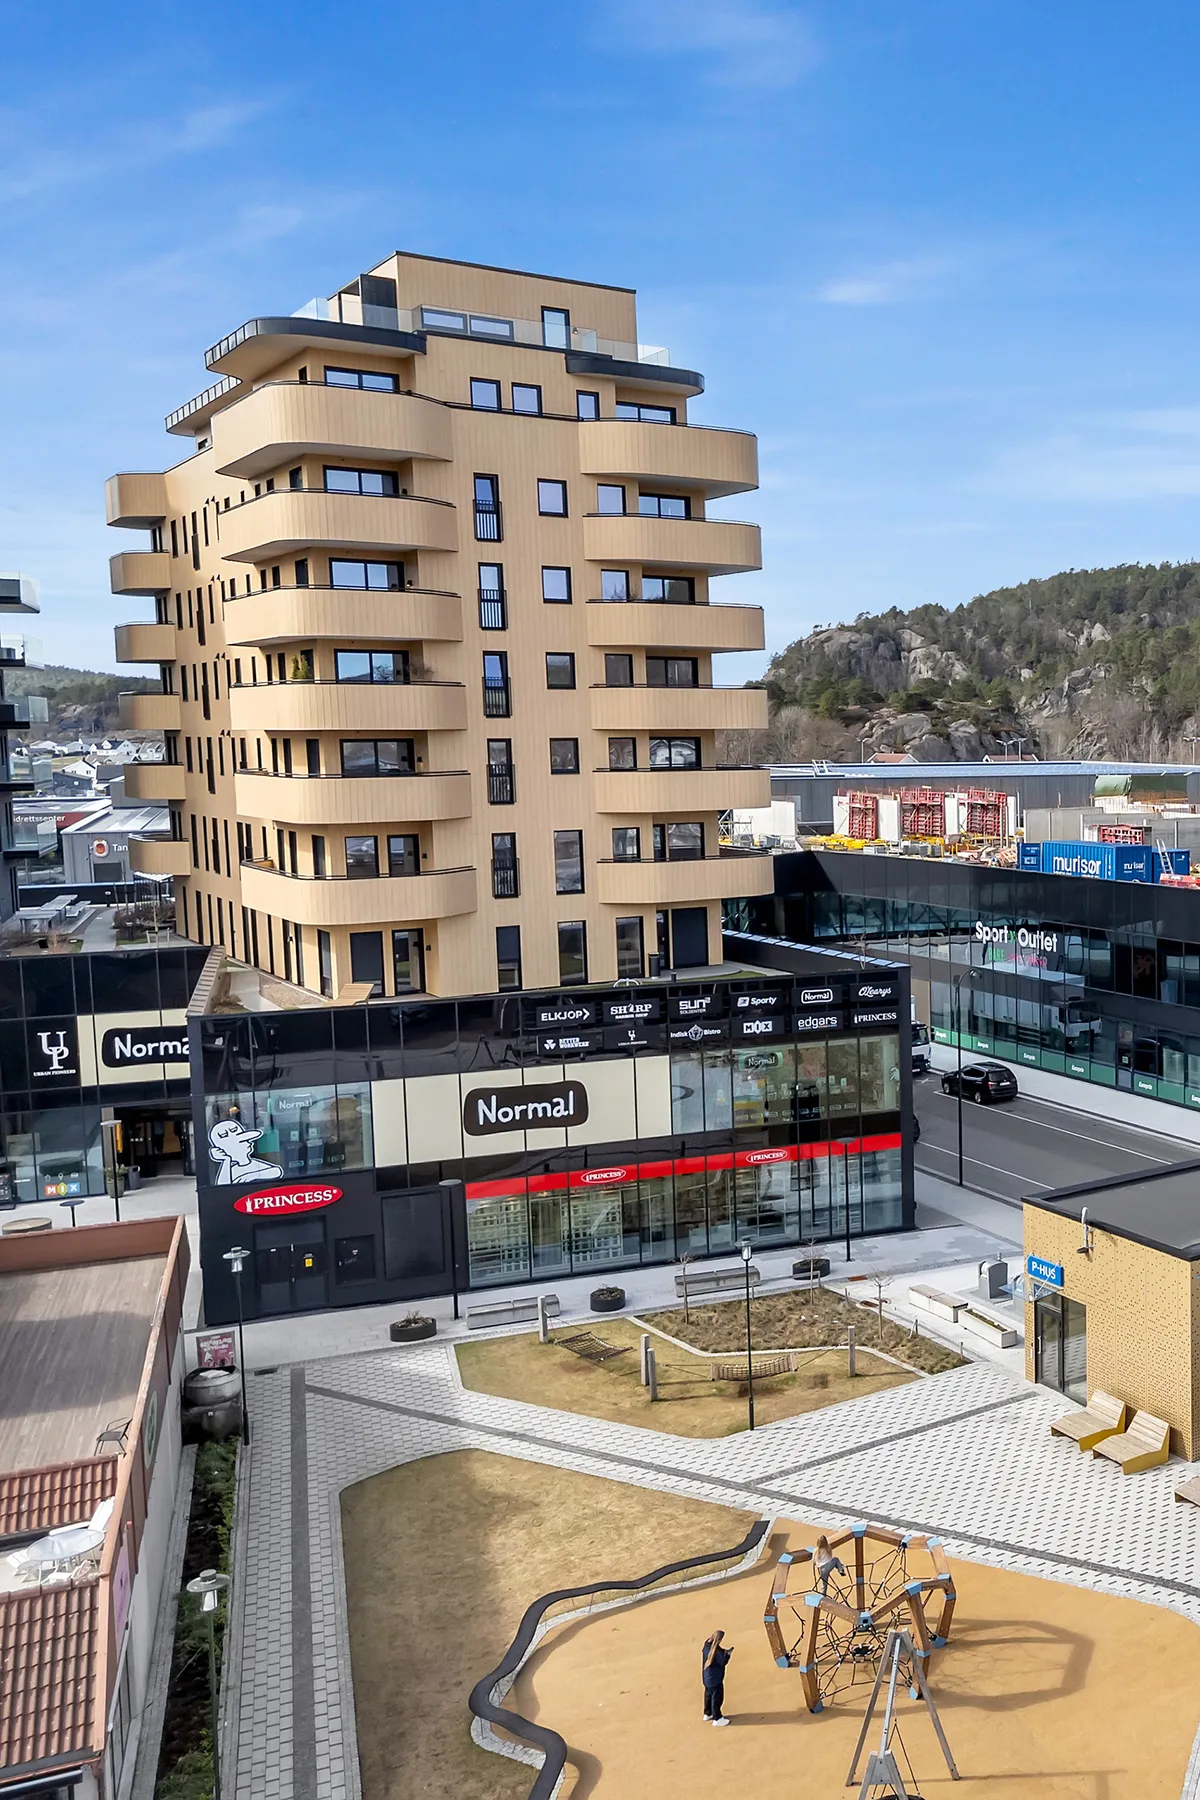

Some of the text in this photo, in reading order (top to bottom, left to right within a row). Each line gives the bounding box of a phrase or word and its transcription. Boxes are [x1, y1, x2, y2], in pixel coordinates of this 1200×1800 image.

[112, 844, 128, 852] Tan
[1053, 855, 1101, 874] murisør
[975, 921, 1057, 952] Sport Outlet
[751, 997, 777, 1006] Sporty
[804, 993, 830, 1001] Normal
[798, 1016, 837, 1029] edgars
[858, 1012, 896, 1022] PRINCESS
[743, 1020, 772, 1034] MIX
[114, 1033, 189, 1059] Norma
[748, 1056, 775, 1066] Normal
[279, 1099, 313, 1110] Normal
[477, 1090, 574, 1126] Normal
[754, 1152, 783, 1161] PRINCESS
[589, 1171, 622, 1181] PRINCESS
[45, 1182, 80, 1196] MIX
[254, 1189, 333, 1210] PRINCESS
[1032, 1261, 1056, 1280] P-HUS
